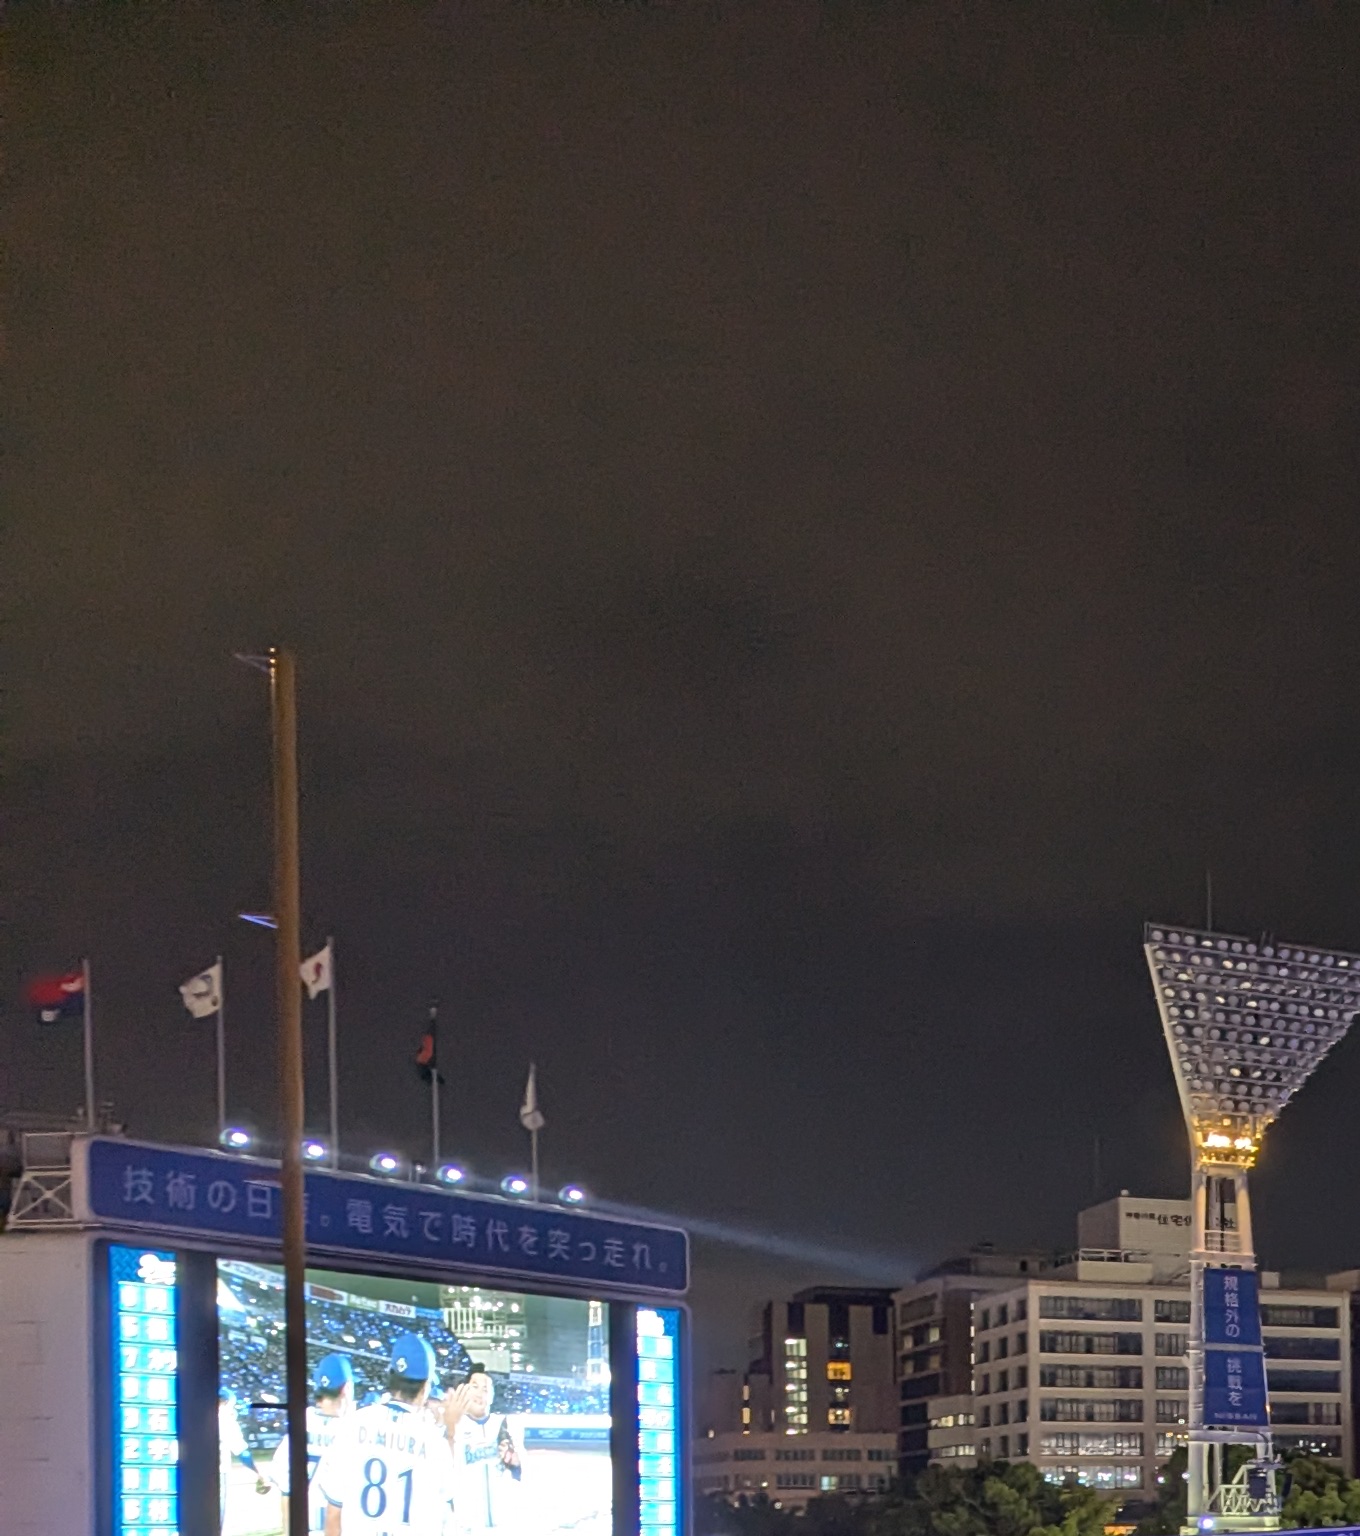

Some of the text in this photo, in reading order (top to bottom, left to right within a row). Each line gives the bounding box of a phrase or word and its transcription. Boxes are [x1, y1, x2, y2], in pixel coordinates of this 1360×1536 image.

[122, 1164, 668, 1273] 技術の日。電気で時代を突っ走れ。
[1223, 1275, 1240, 1339] 規格外の
[1226, 1357, 1242, 1407] 挑戦を
[357, 1425, 427, 1457] D.MIURA
[359, 1456, 414, 1526] 81
